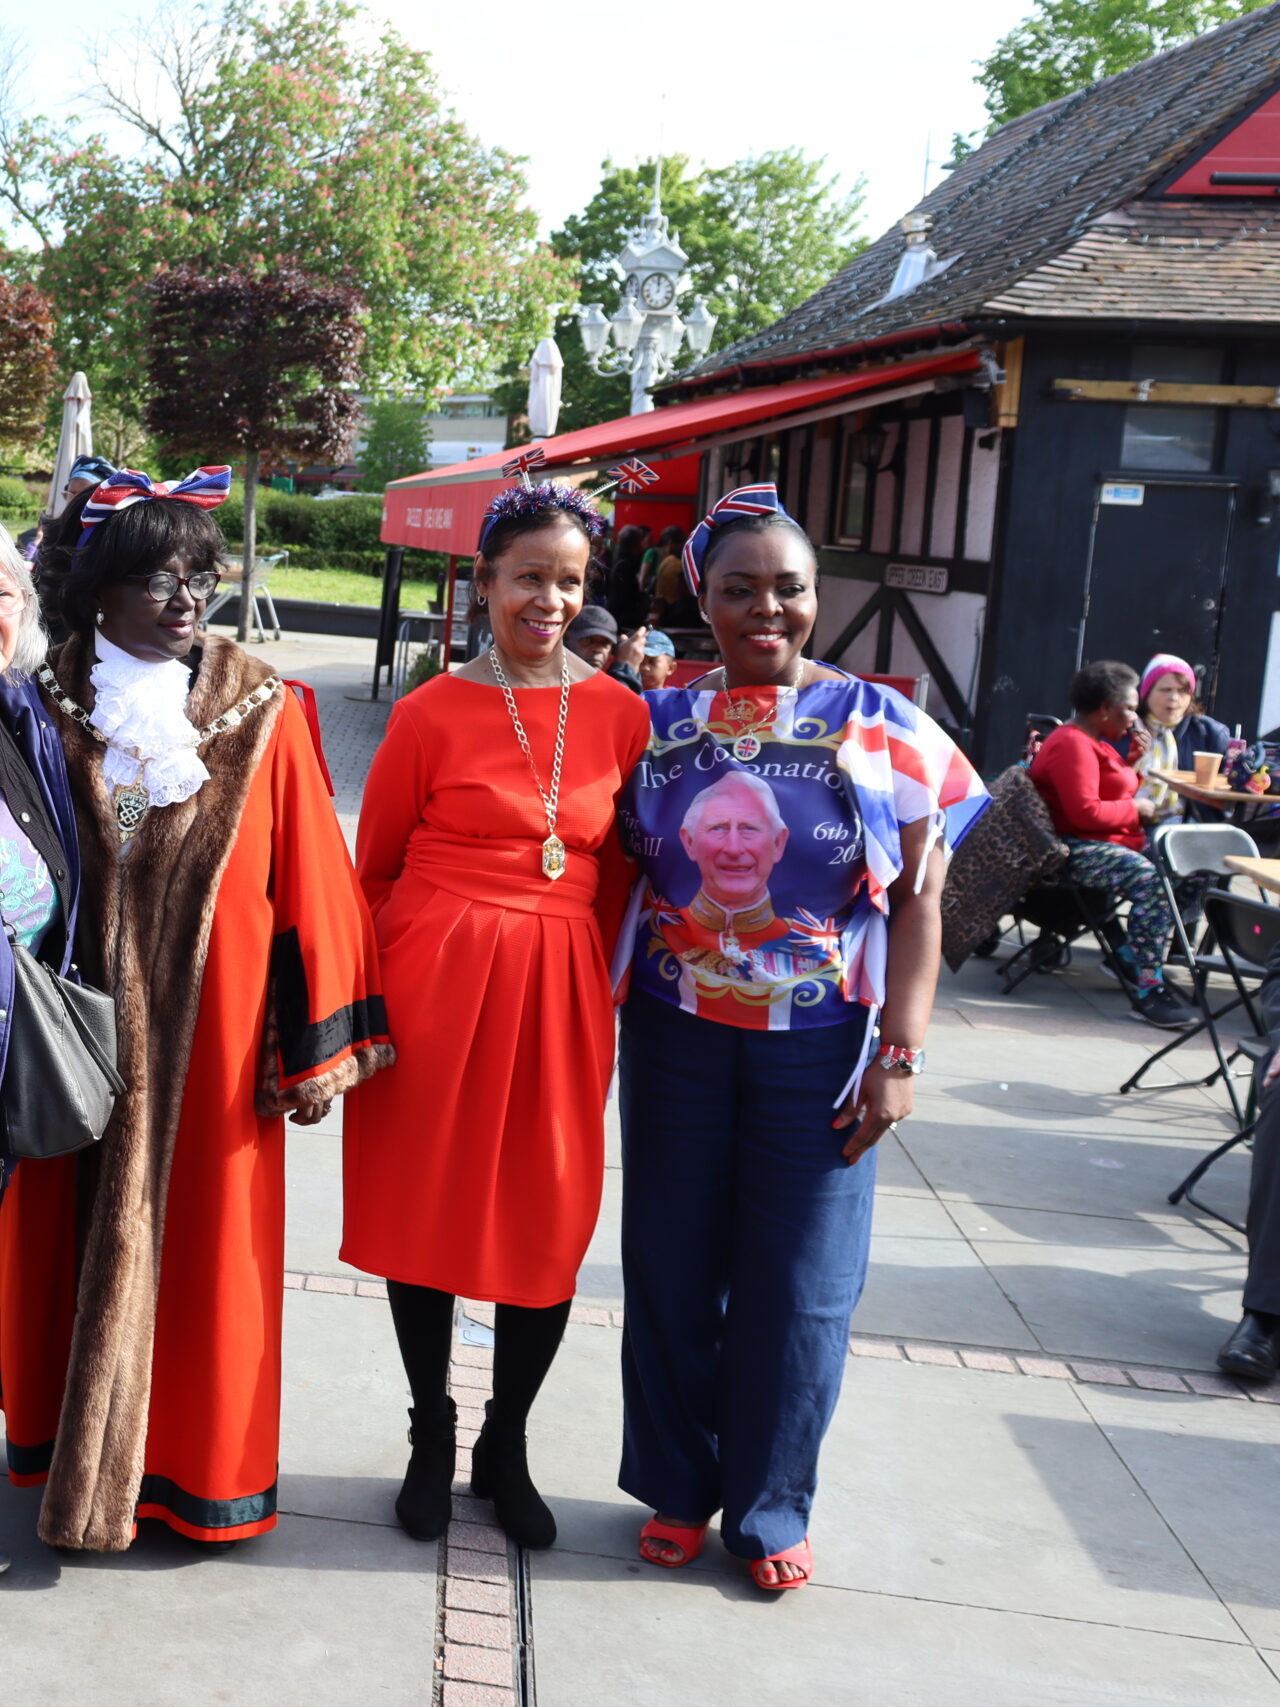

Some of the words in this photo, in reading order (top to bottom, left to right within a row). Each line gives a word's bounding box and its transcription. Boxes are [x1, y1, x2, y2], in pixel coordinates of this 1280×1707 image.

[634, 761, 683, 789] The
[694, 742, 846, 798] Coonatio
[813, 821, 849, 841] 6th
